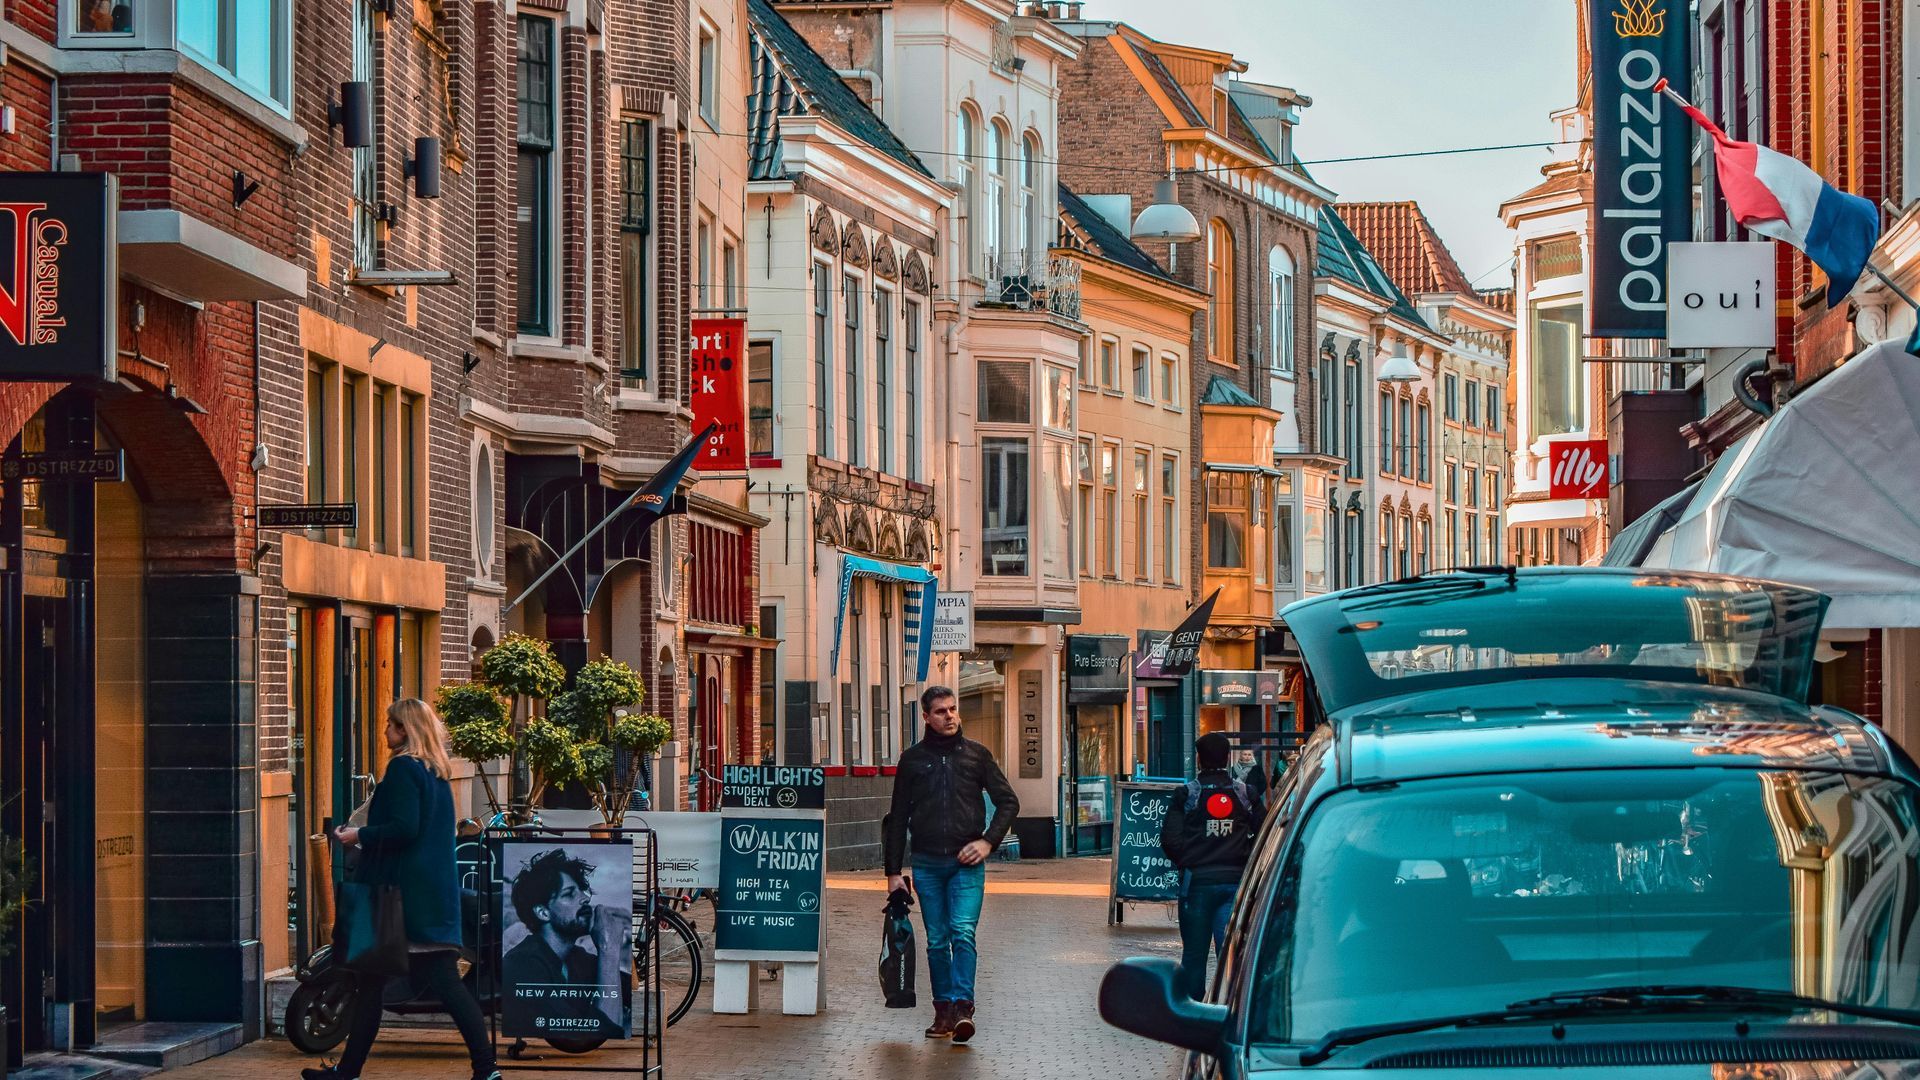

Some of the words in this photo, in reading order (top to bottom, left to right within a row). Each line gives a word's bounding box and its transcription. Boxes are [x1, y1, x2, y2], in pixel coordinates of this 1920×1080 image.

[1603, 49, 1666, 311] palazzo
[37, 218, 68, 344] Casuals
[710, 433, 724, 445] of
[710, 447, 731, 457] art
[27, 459, 115, 475] DSTREZZED
[1553, 447, 1605, 495] illy
[281, 511, 351, 522] DSTREZZED
[1175, 631, 1203, 643] GENT
[1074, 653, 1090, 667] Pure
[1026, 681, 1039, 699] in
[724, 786, 771, 796] STUDENT
[744, 796, 771, 807] DEAL
[1130, 791, 1169, 821] Coffe
[757, 851, 820, 871] FRIDAY
[1132, 855, 1140, 866] a
[736, 877, 760, 888] HIGH
[768, 879, 790, 890] TEA
[1129, 873, 1166, 888] idea
[736, 891, 750, 901] OF
[755, 891, 782, 902] WINE
[731, 915, 756, 926] LIVE
[763, 916, 795, 927] MUSIC
[515, 989, 545, 998] NEW
[550, 989, 619, 999] ARRIVALS
[549, 1018, 601, 1028] DSTREZZED
